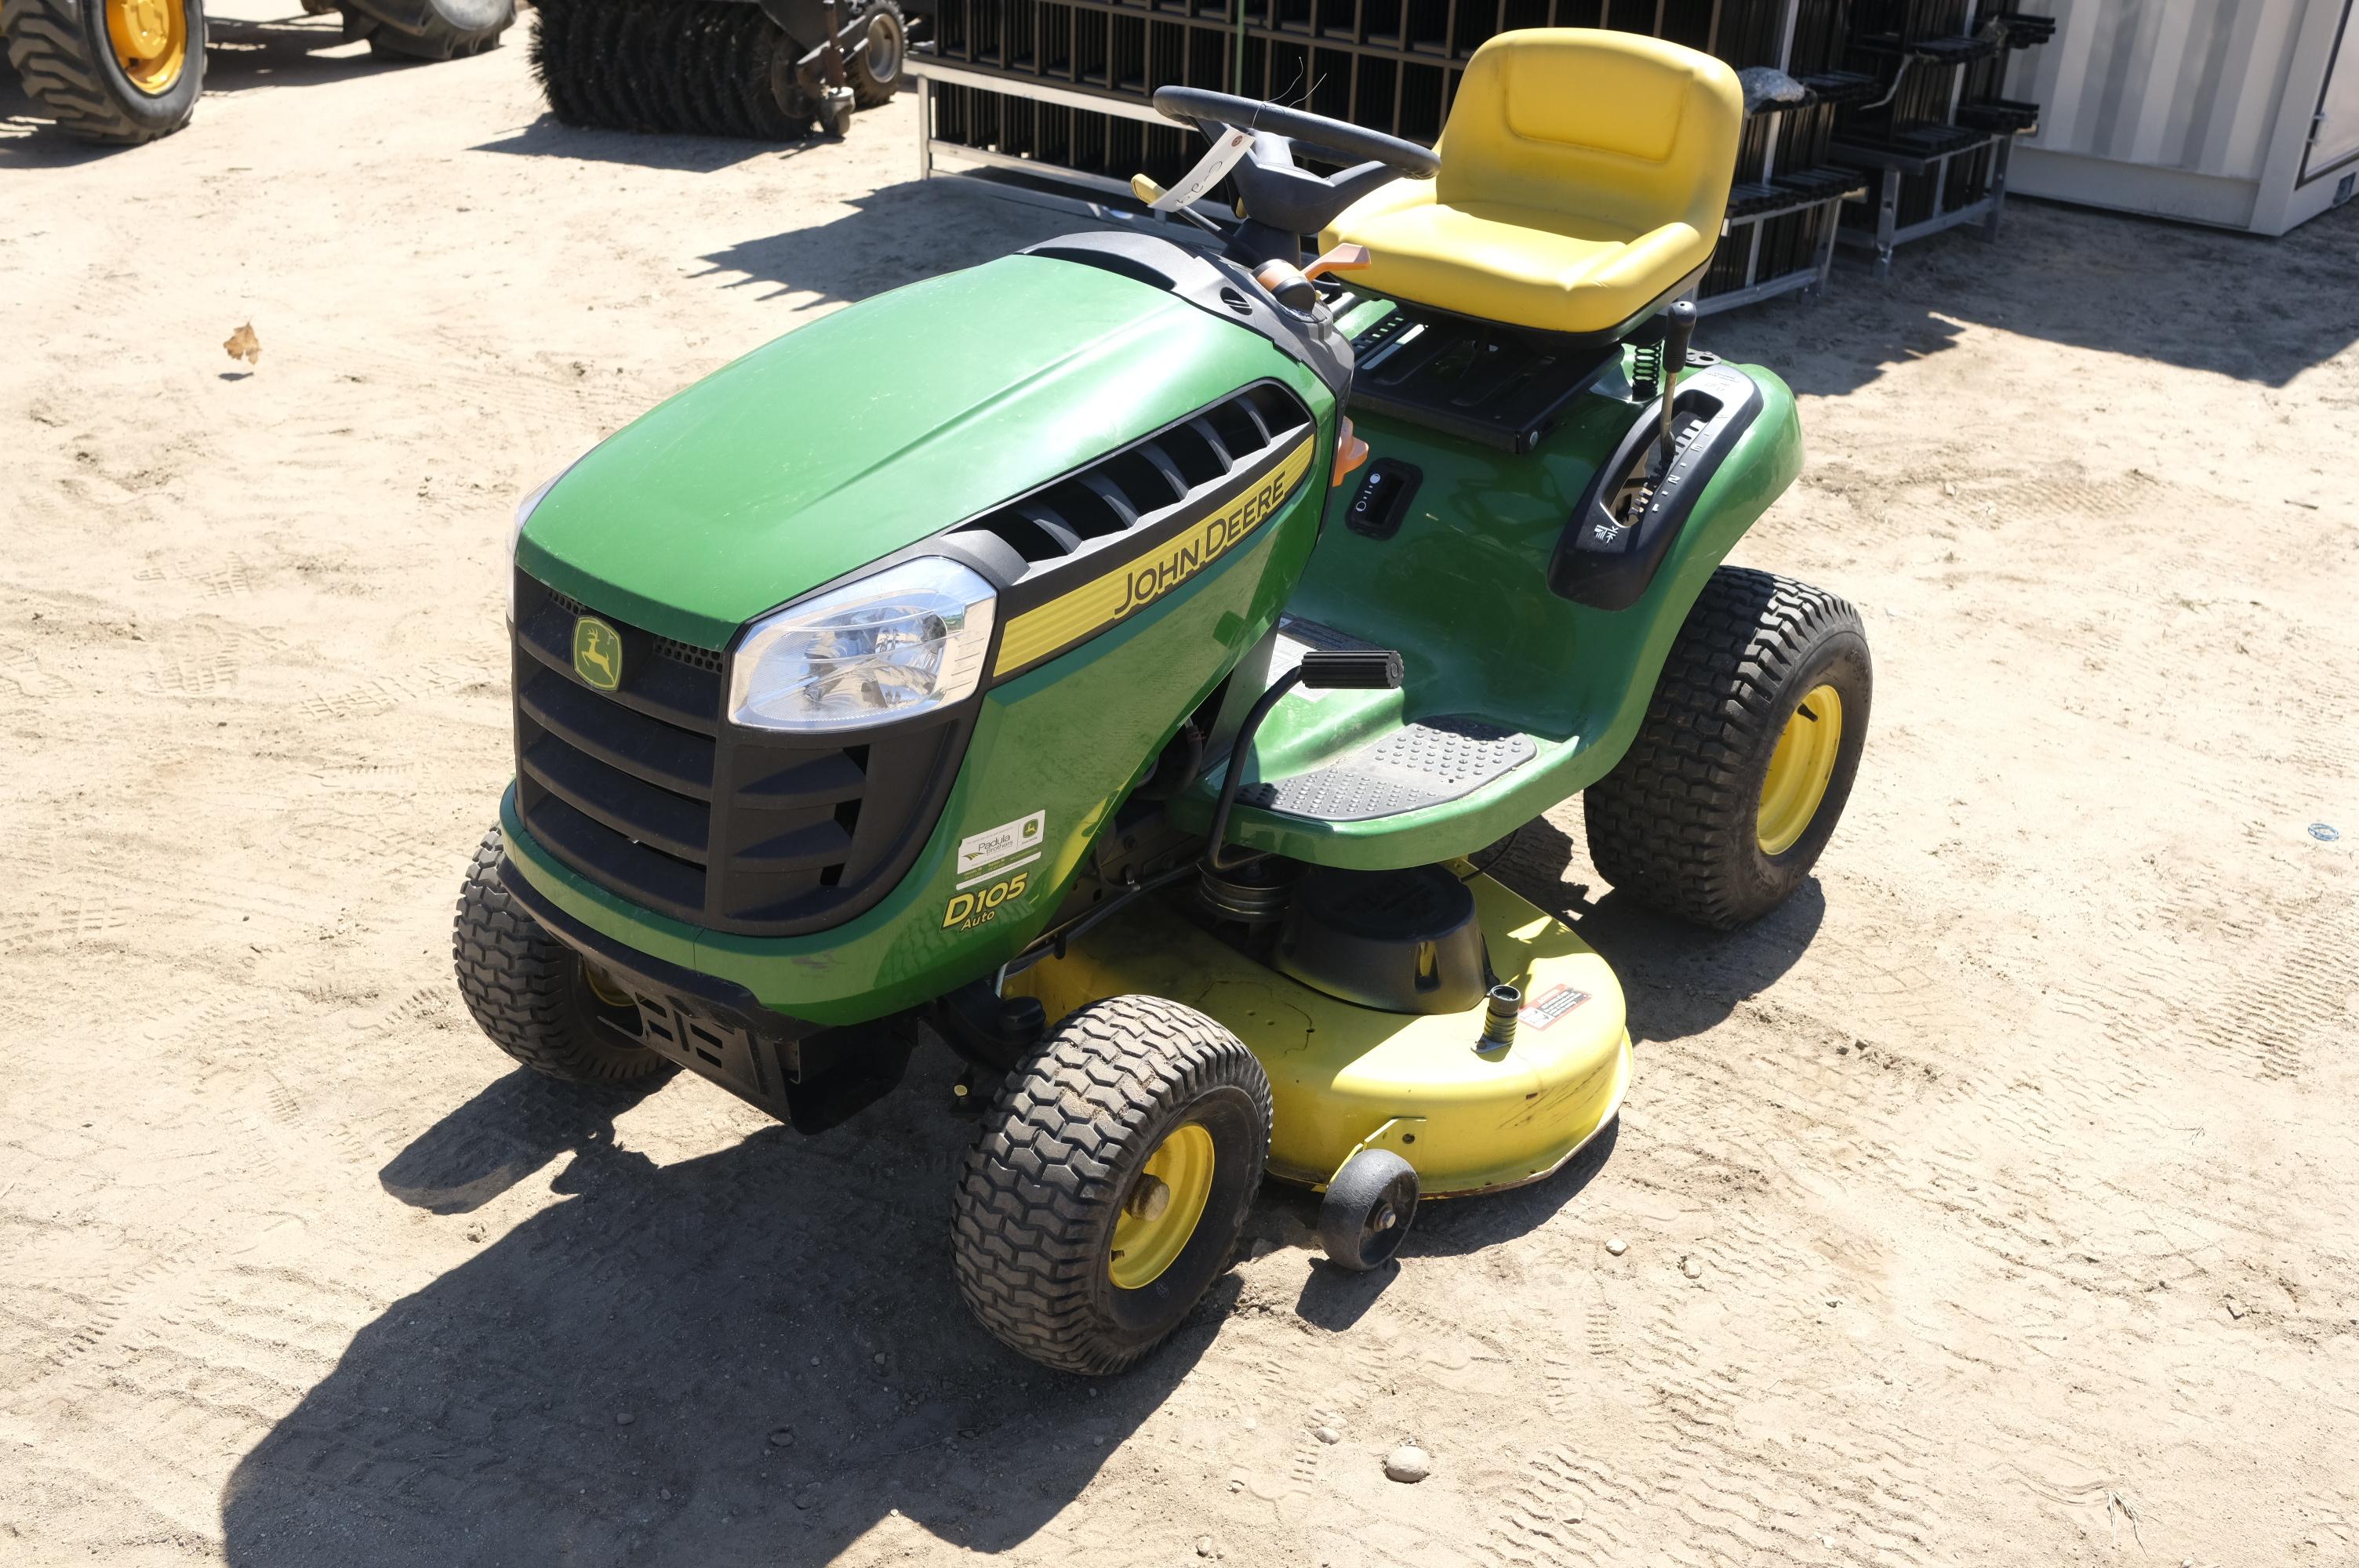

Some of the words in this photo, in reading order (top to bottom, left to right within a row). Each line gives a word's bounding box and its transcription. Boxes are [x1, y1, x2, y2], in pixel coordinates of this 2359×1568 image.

[1114, 538, 1201, 608] JOHN
[1205, 470, 1294, 559] DEERE
[978, 833, 1011, 852] Padula
[942, 870, 1030, 929] D105
[959, 909, 996, 933] Auto
